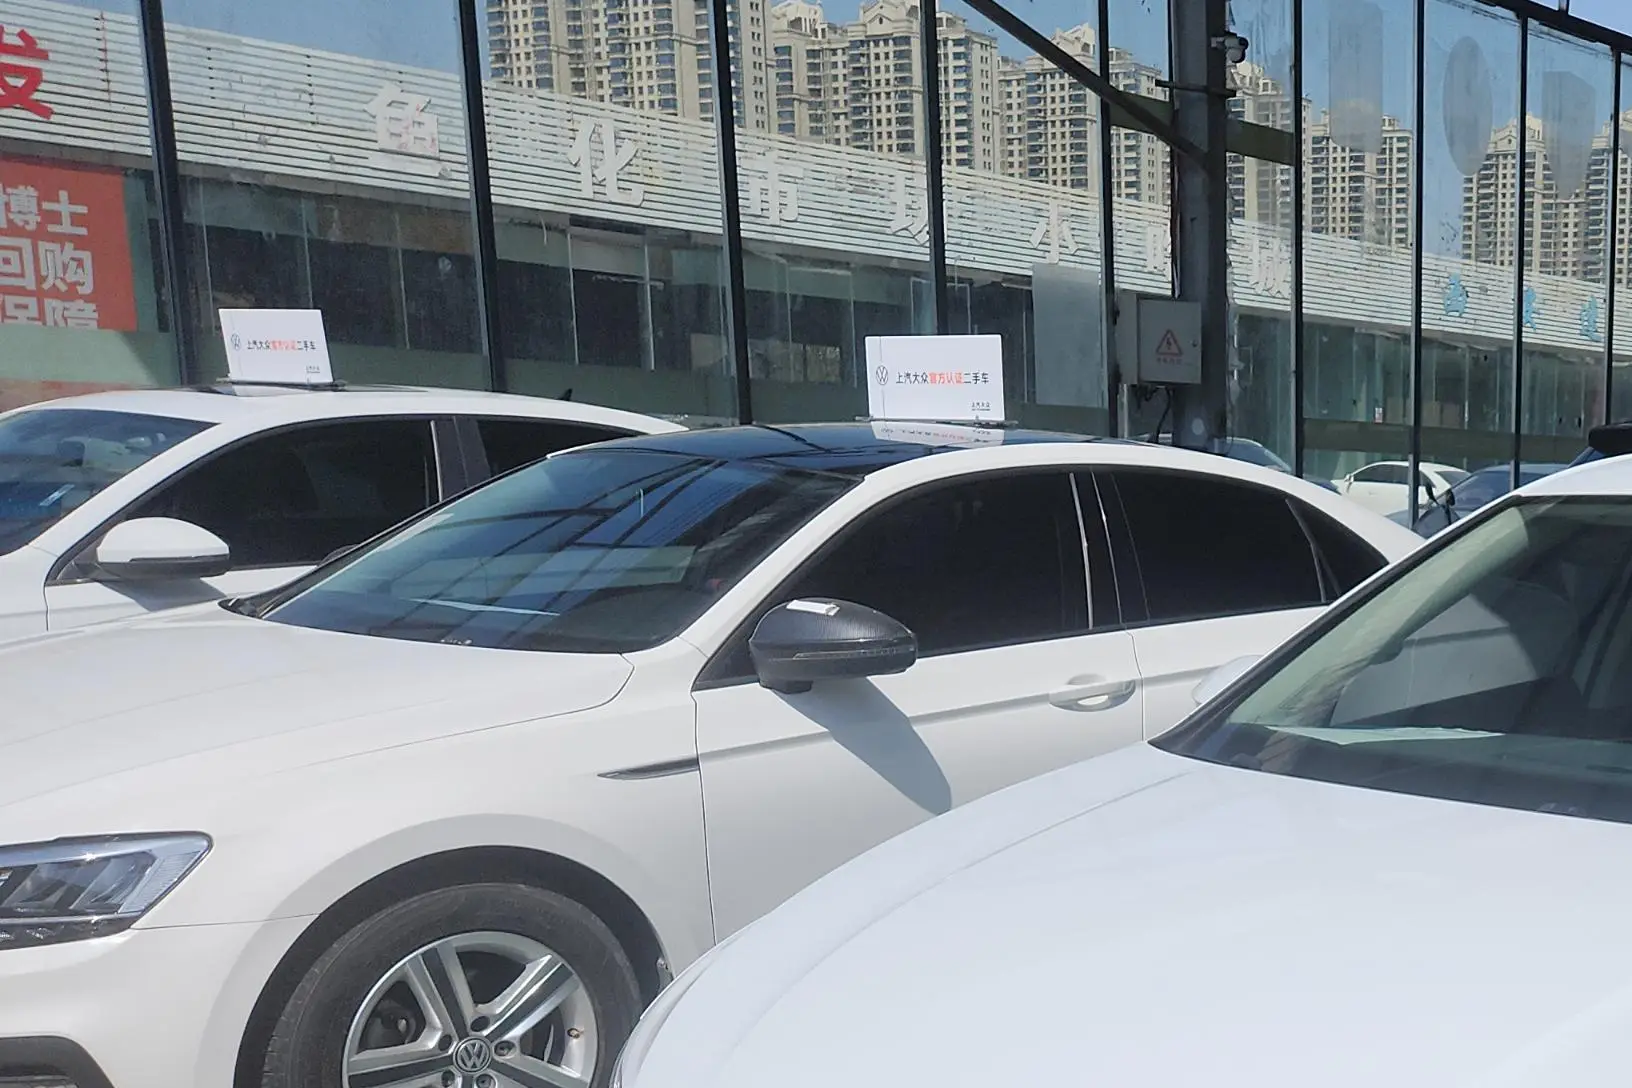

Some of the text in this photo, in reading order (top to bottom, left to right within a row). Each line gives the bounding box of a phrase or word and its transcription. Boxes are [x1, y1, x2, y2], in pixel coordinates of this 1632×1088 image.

[896, 371, 989, 385] 上汽大众官方认证二手车
